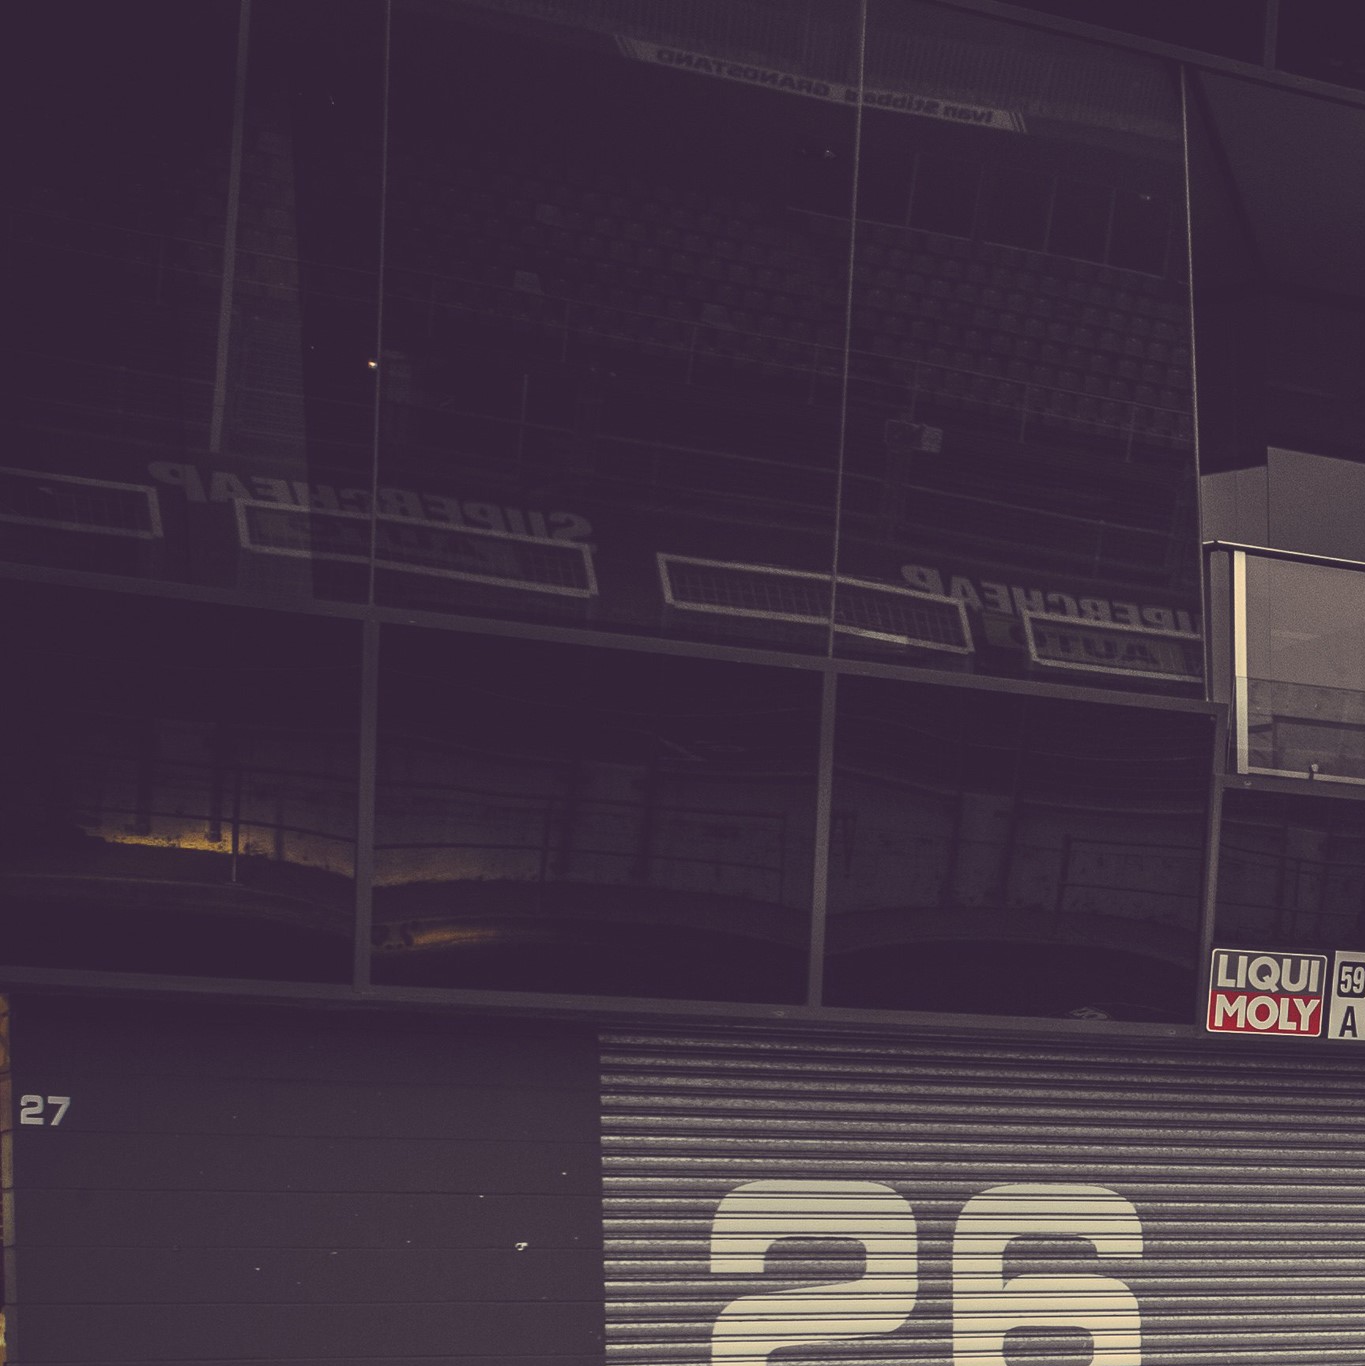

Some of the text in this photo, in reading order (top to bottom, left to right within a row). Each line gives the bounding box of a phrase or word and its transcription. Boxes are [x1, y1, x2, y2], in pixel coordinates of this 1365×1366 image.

[1217, 954, 1320, 992] LIQUI
[1340, 966, 1365, 993] 59
[1214, 994, 1320, 1031] MOLY
[1339, 1006, 1358, 1038] A
[20, 1095, 71, 1126] 27
